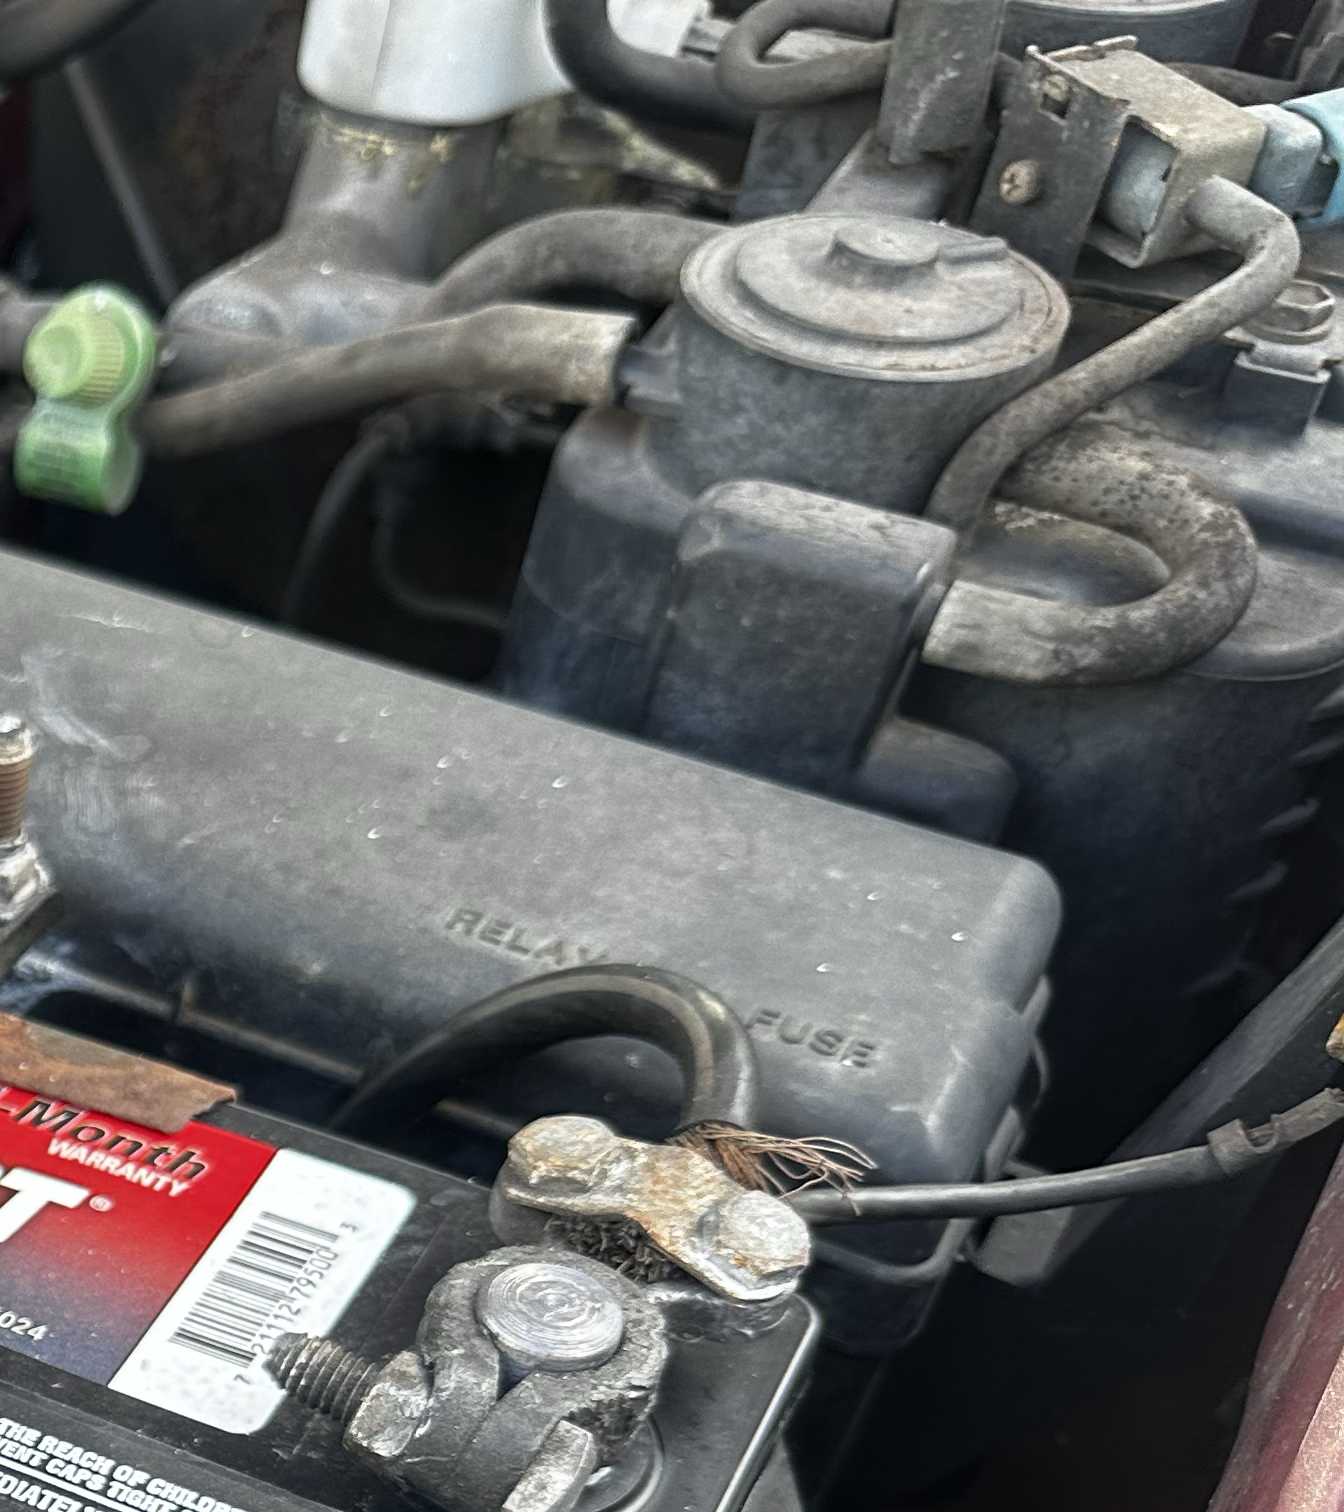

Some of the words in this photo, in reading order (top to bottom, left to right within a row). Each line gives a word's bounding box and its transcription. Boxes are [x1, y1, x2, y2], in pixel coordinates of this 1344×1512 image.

[747, 1007, 880, 1069] FUSE
[47, 1136, 192, 1198] WARRANTY
[37, 1435, 115, 1476] REACH
[112, 1465, 151, 1487] OF
[45, 1458, 108, 1491] CAPS
